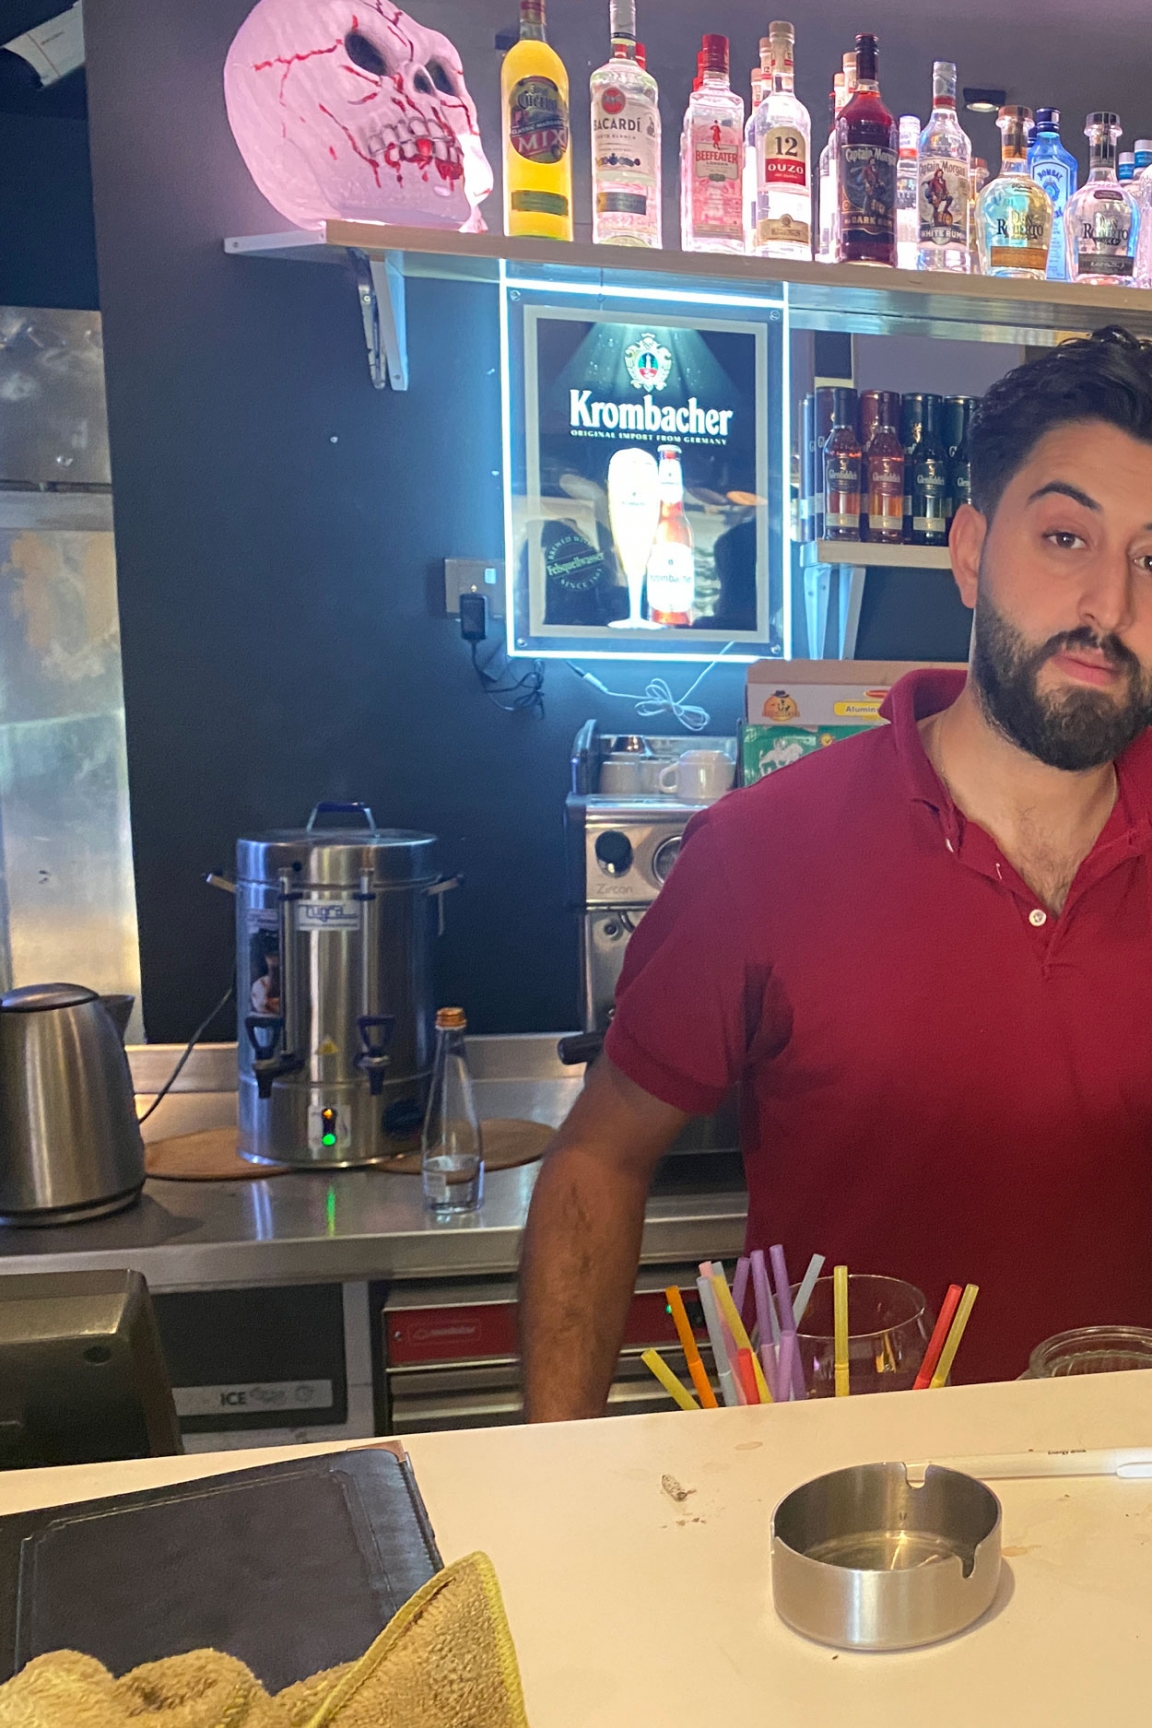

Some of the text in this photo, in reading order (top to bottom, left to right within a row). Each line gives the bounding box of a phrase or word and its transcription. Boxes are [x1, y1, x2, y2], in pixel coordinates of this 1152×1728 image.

[519, 129, 565, 152] MIX
[775, 136, 798, 157] 12
[695, 150, 737, 164] BEEFEATER
[767, 163, 804, 174] OUZO
[1037, 168, 1063, 182] BOMBAY
[569, 388, 734, 437] Krombacher
[570, 429, 728, 446] ORIGINAL IMPORT FROM GERMANY
[846, 705, 879, 713] Alumin
[220, 1391, 246, 1406] ICE
